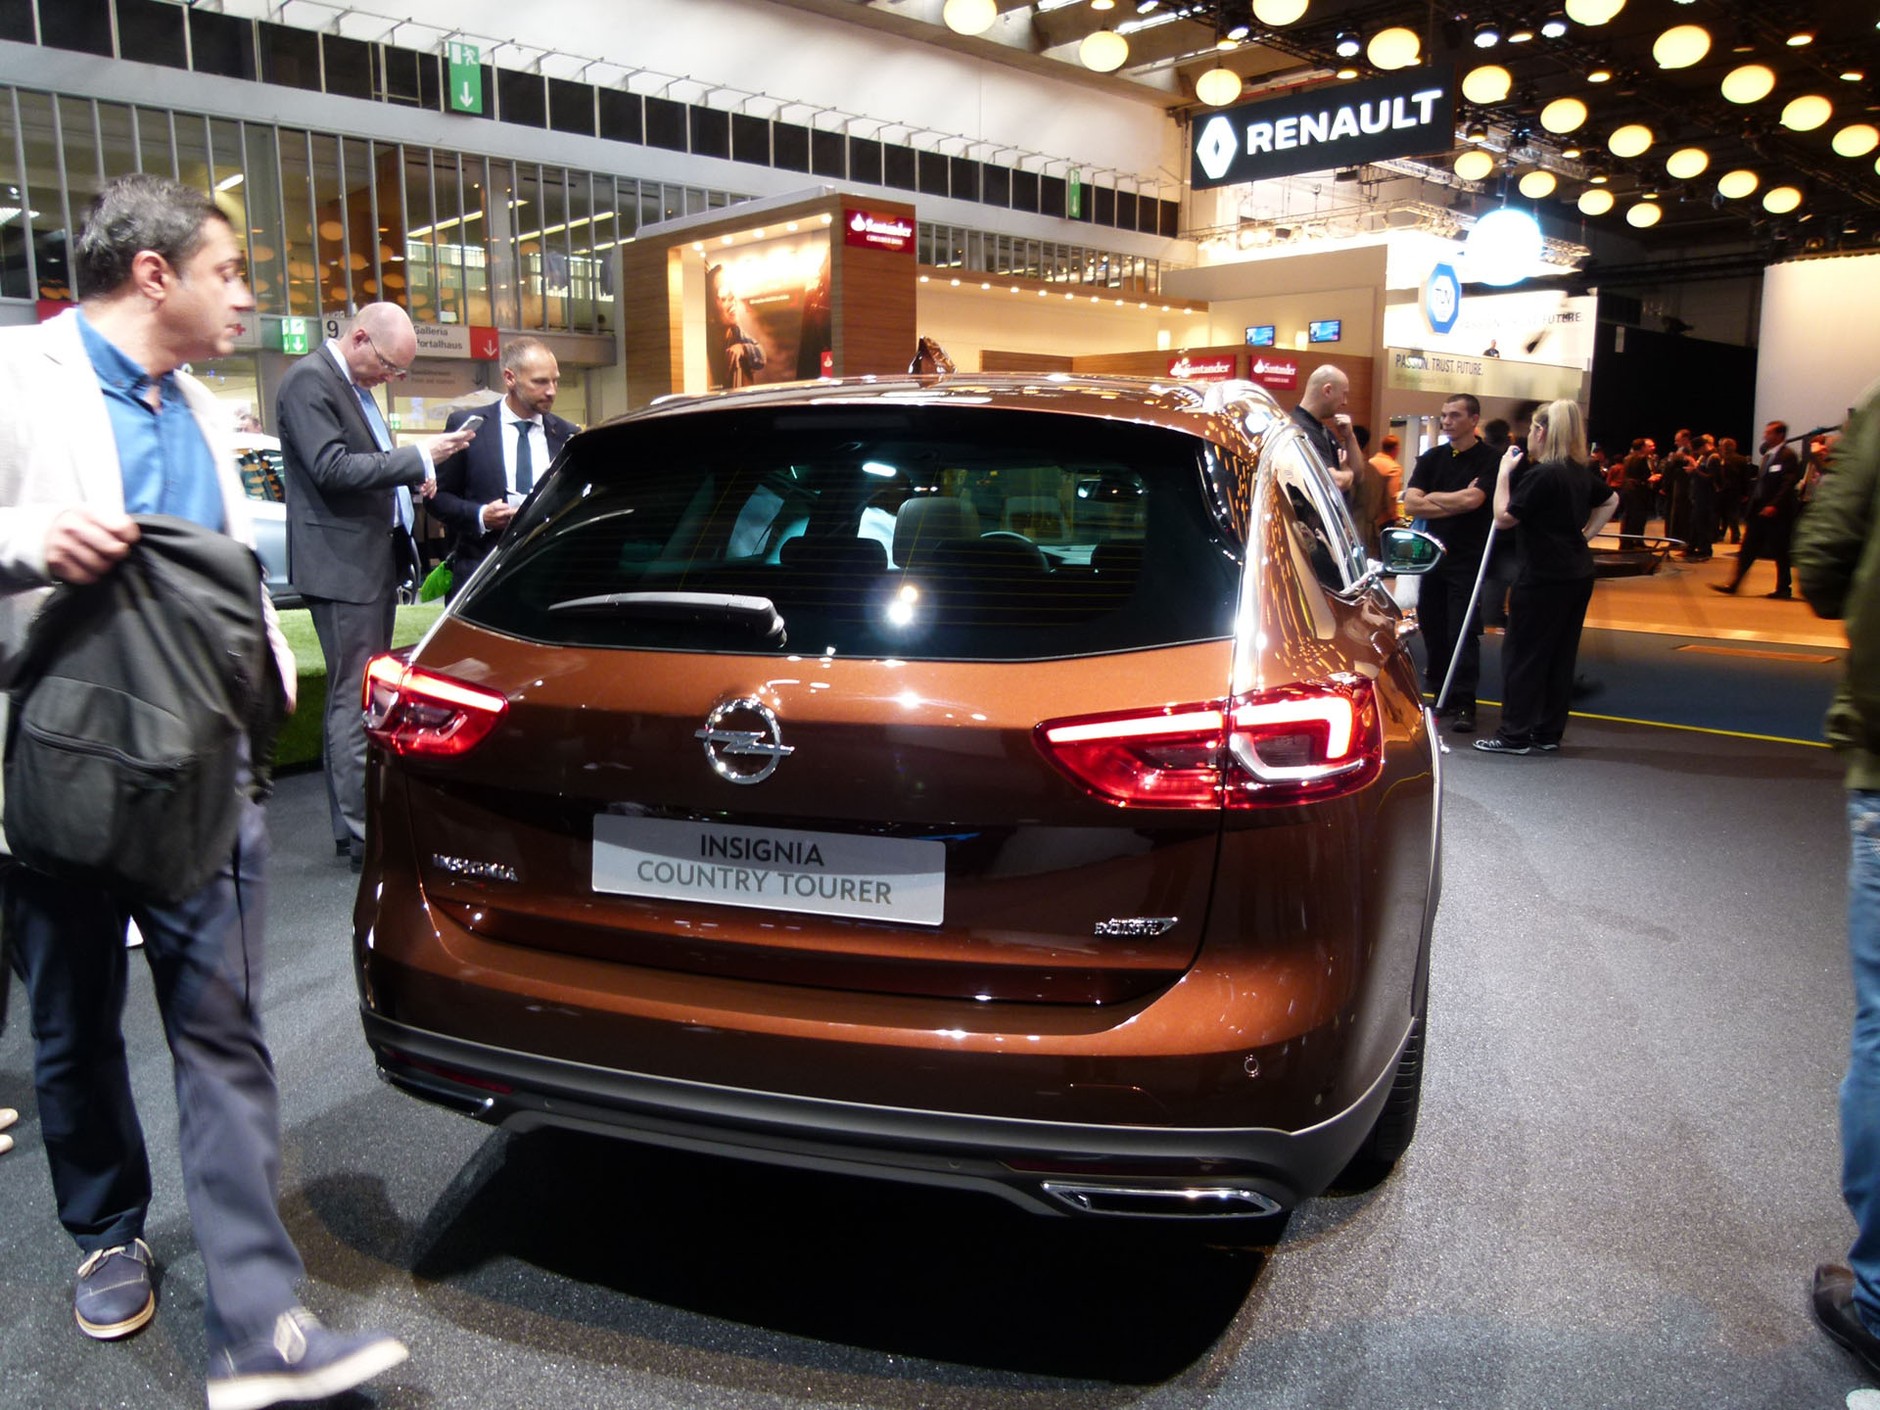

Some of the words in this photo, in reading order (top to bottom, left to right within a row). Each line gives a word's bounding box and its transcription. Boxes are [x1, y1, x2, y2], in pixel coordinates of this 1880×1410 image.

[1246, 89, 1443, 156] RENAULT
[326, 319, 339, 339] 9
[413, 325, 449, 336] Galleria
[701, 834, 825, 867] INSIGNIA
[637, 860, 770, 893] COUNTRY
[778, 873, 892, 905] TOURER
